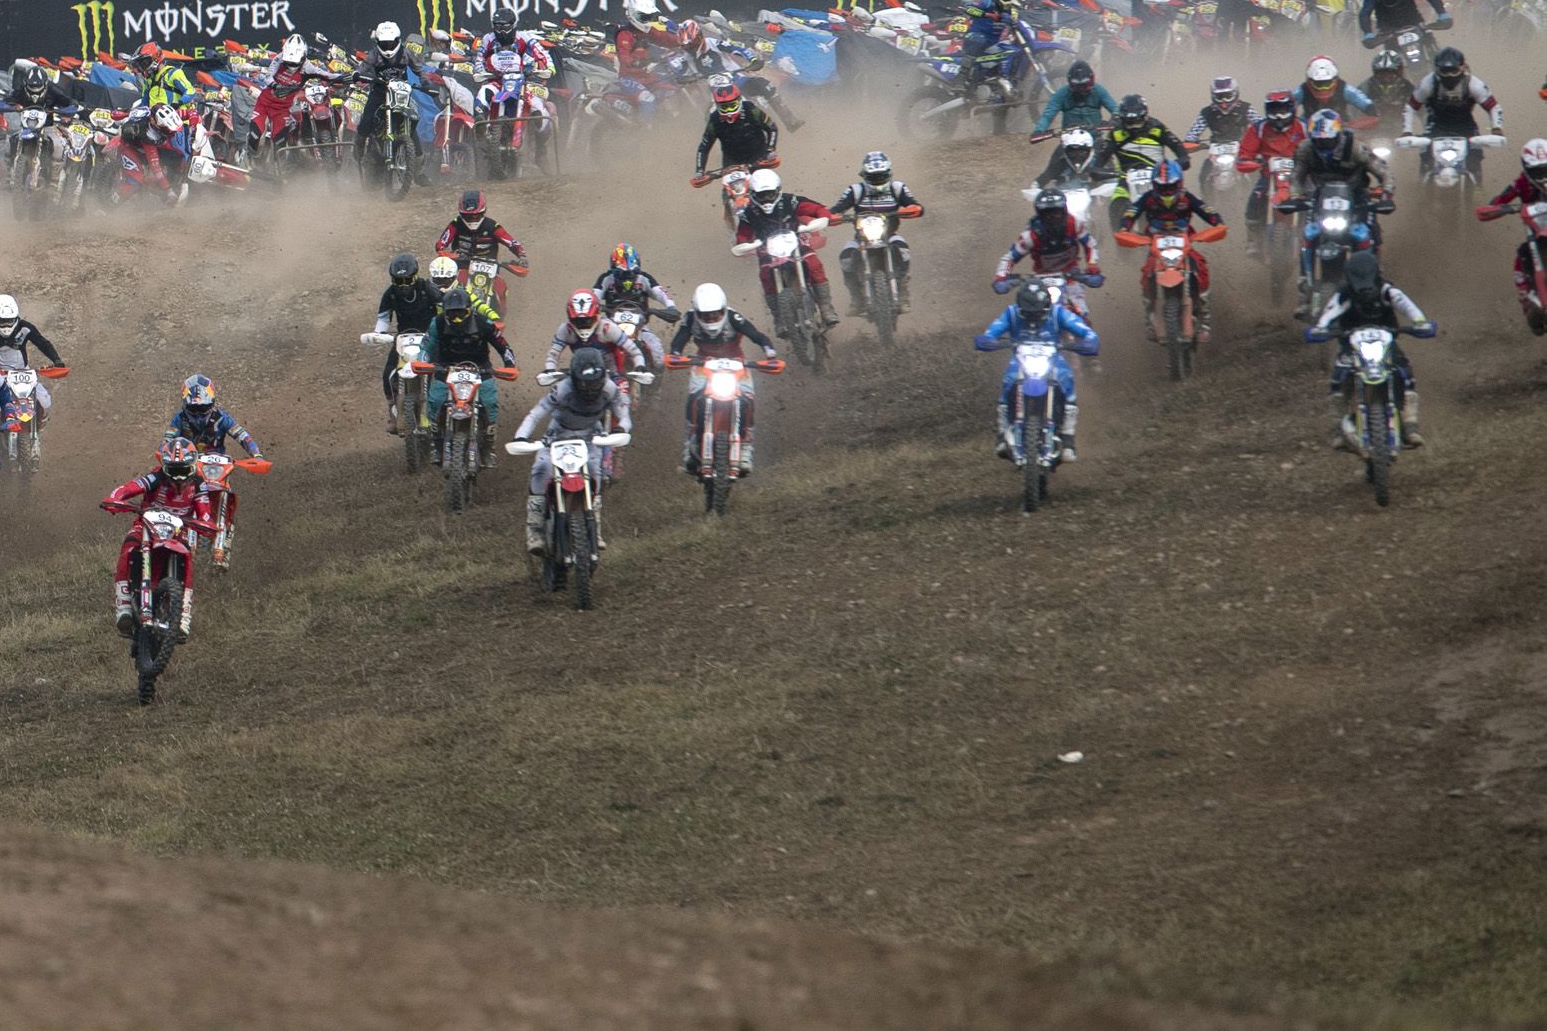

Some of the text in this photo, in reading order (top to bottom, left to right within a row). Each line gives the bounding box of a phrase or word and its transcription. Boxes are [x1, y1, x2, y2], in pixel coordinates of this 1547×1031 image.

[123, 0, 295, 42] MONSTER
[475, 264, 491, 273] 107
[621, 313, 633, 322] 62
[409, 337, 415, 345] 2
[14, 374, 31, 382] 100
[457, 372, 471, 381] 93
[562, 446, 577, 457] 23
[158, 513, 172, 523] 94
